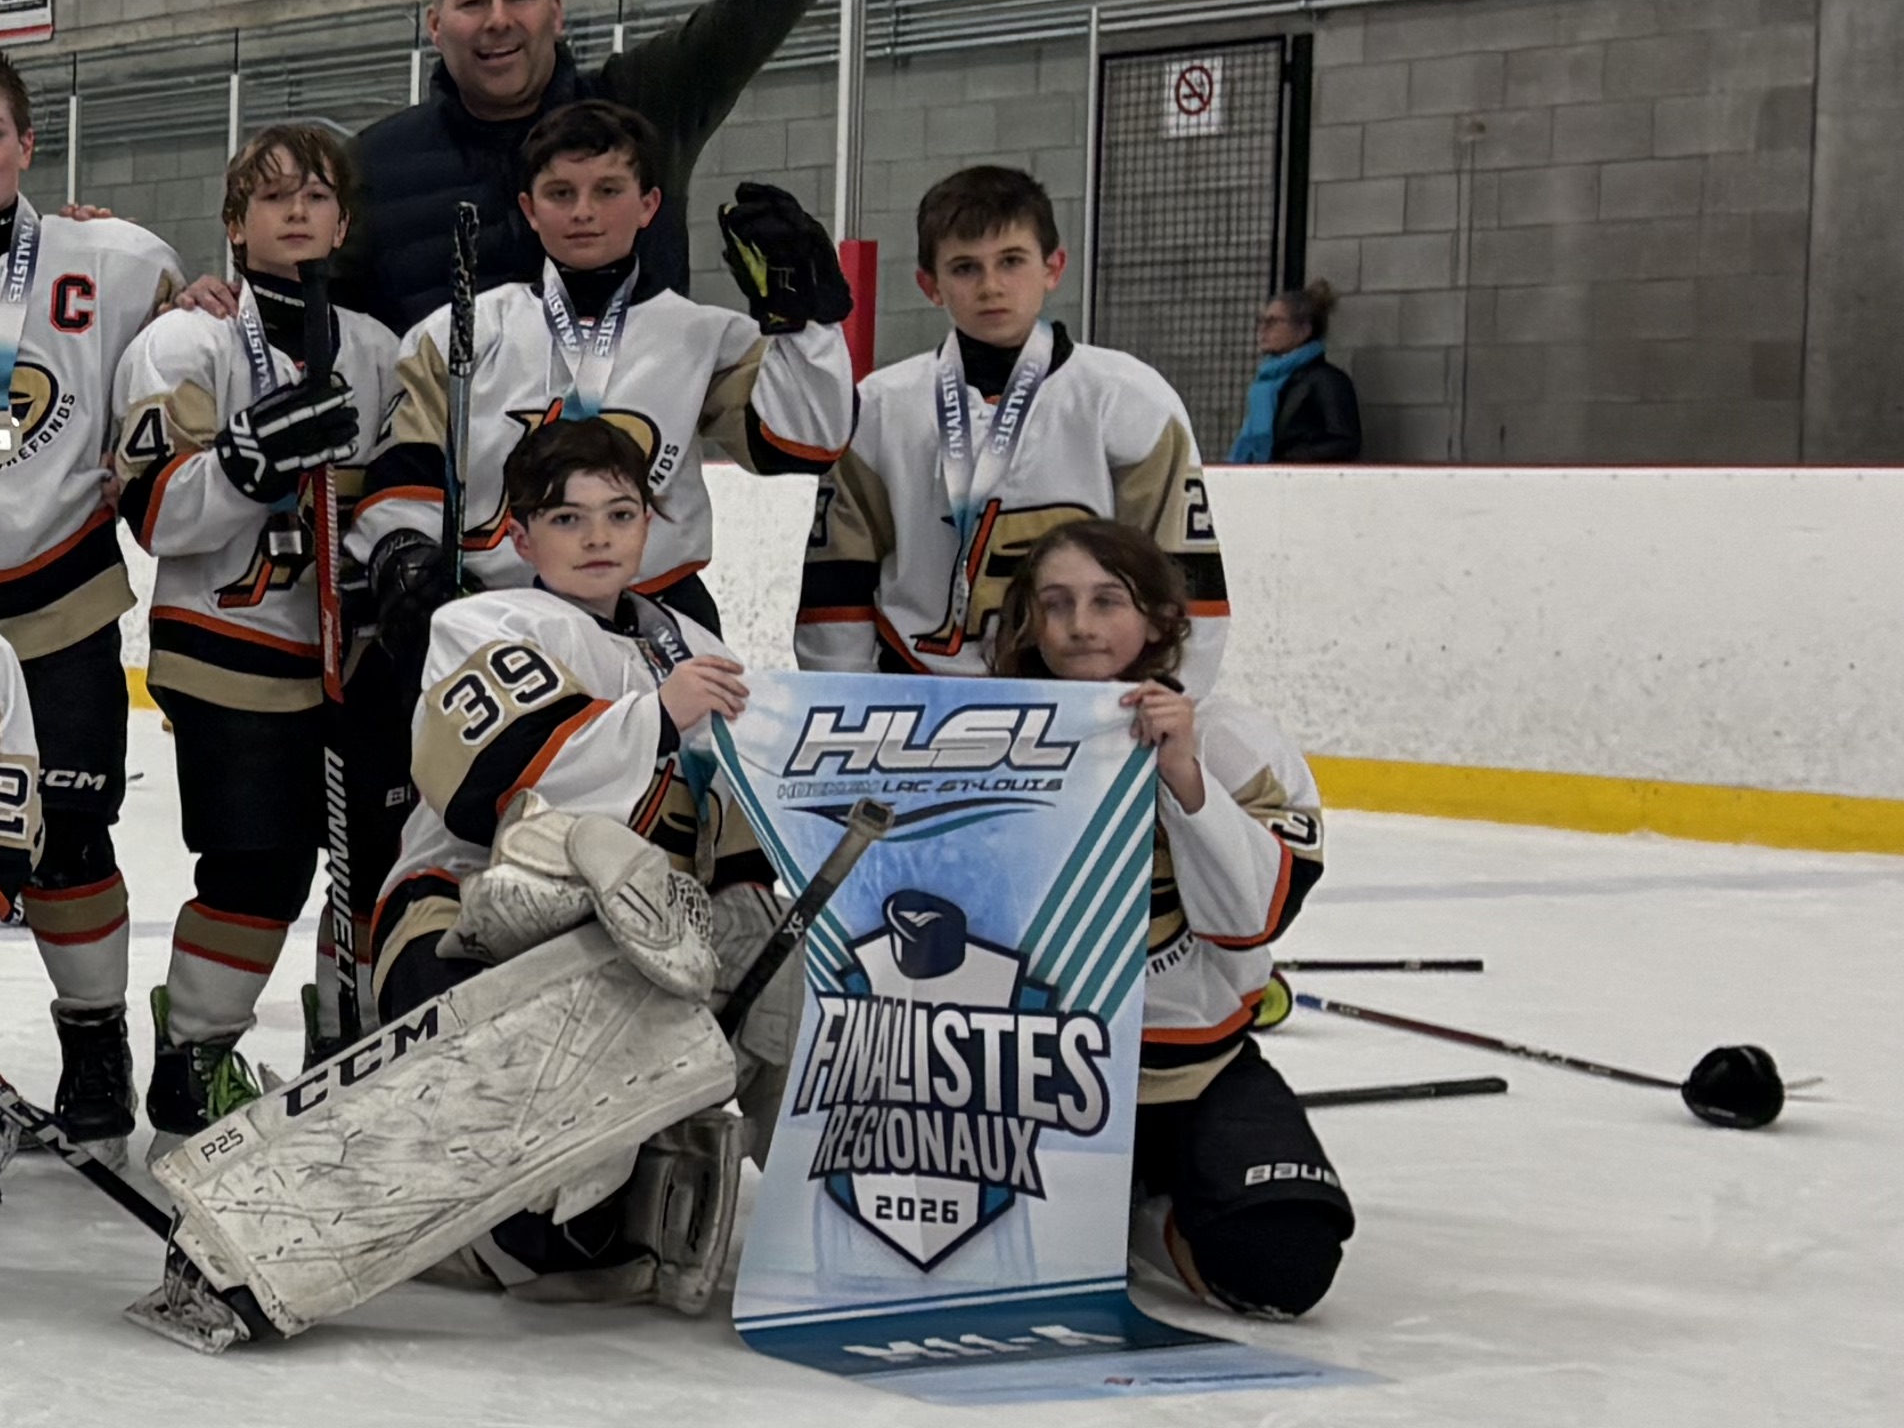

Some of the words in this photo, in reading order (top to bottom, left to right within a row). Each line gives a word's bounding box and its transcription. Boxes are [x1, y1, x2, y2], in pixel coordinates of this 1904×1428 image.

[50, 273, 96, 334] C
[122, 404, 176, 462] 4
[442, 644, 564, 746] 39
[783, 702, 1080, 776] HLSL
[38, 769, 107, 793] CM
[882, 778, 932, 794] LAC
[935, 777, 1063, 794] ST-LOUIS
[280, 1004, 438, 1118] CCM
[796, 996, 1106, 1132] FINALISTES
[200, 1126, 245, 1163] P25
[875, 1195, 959, 1224] 2026
